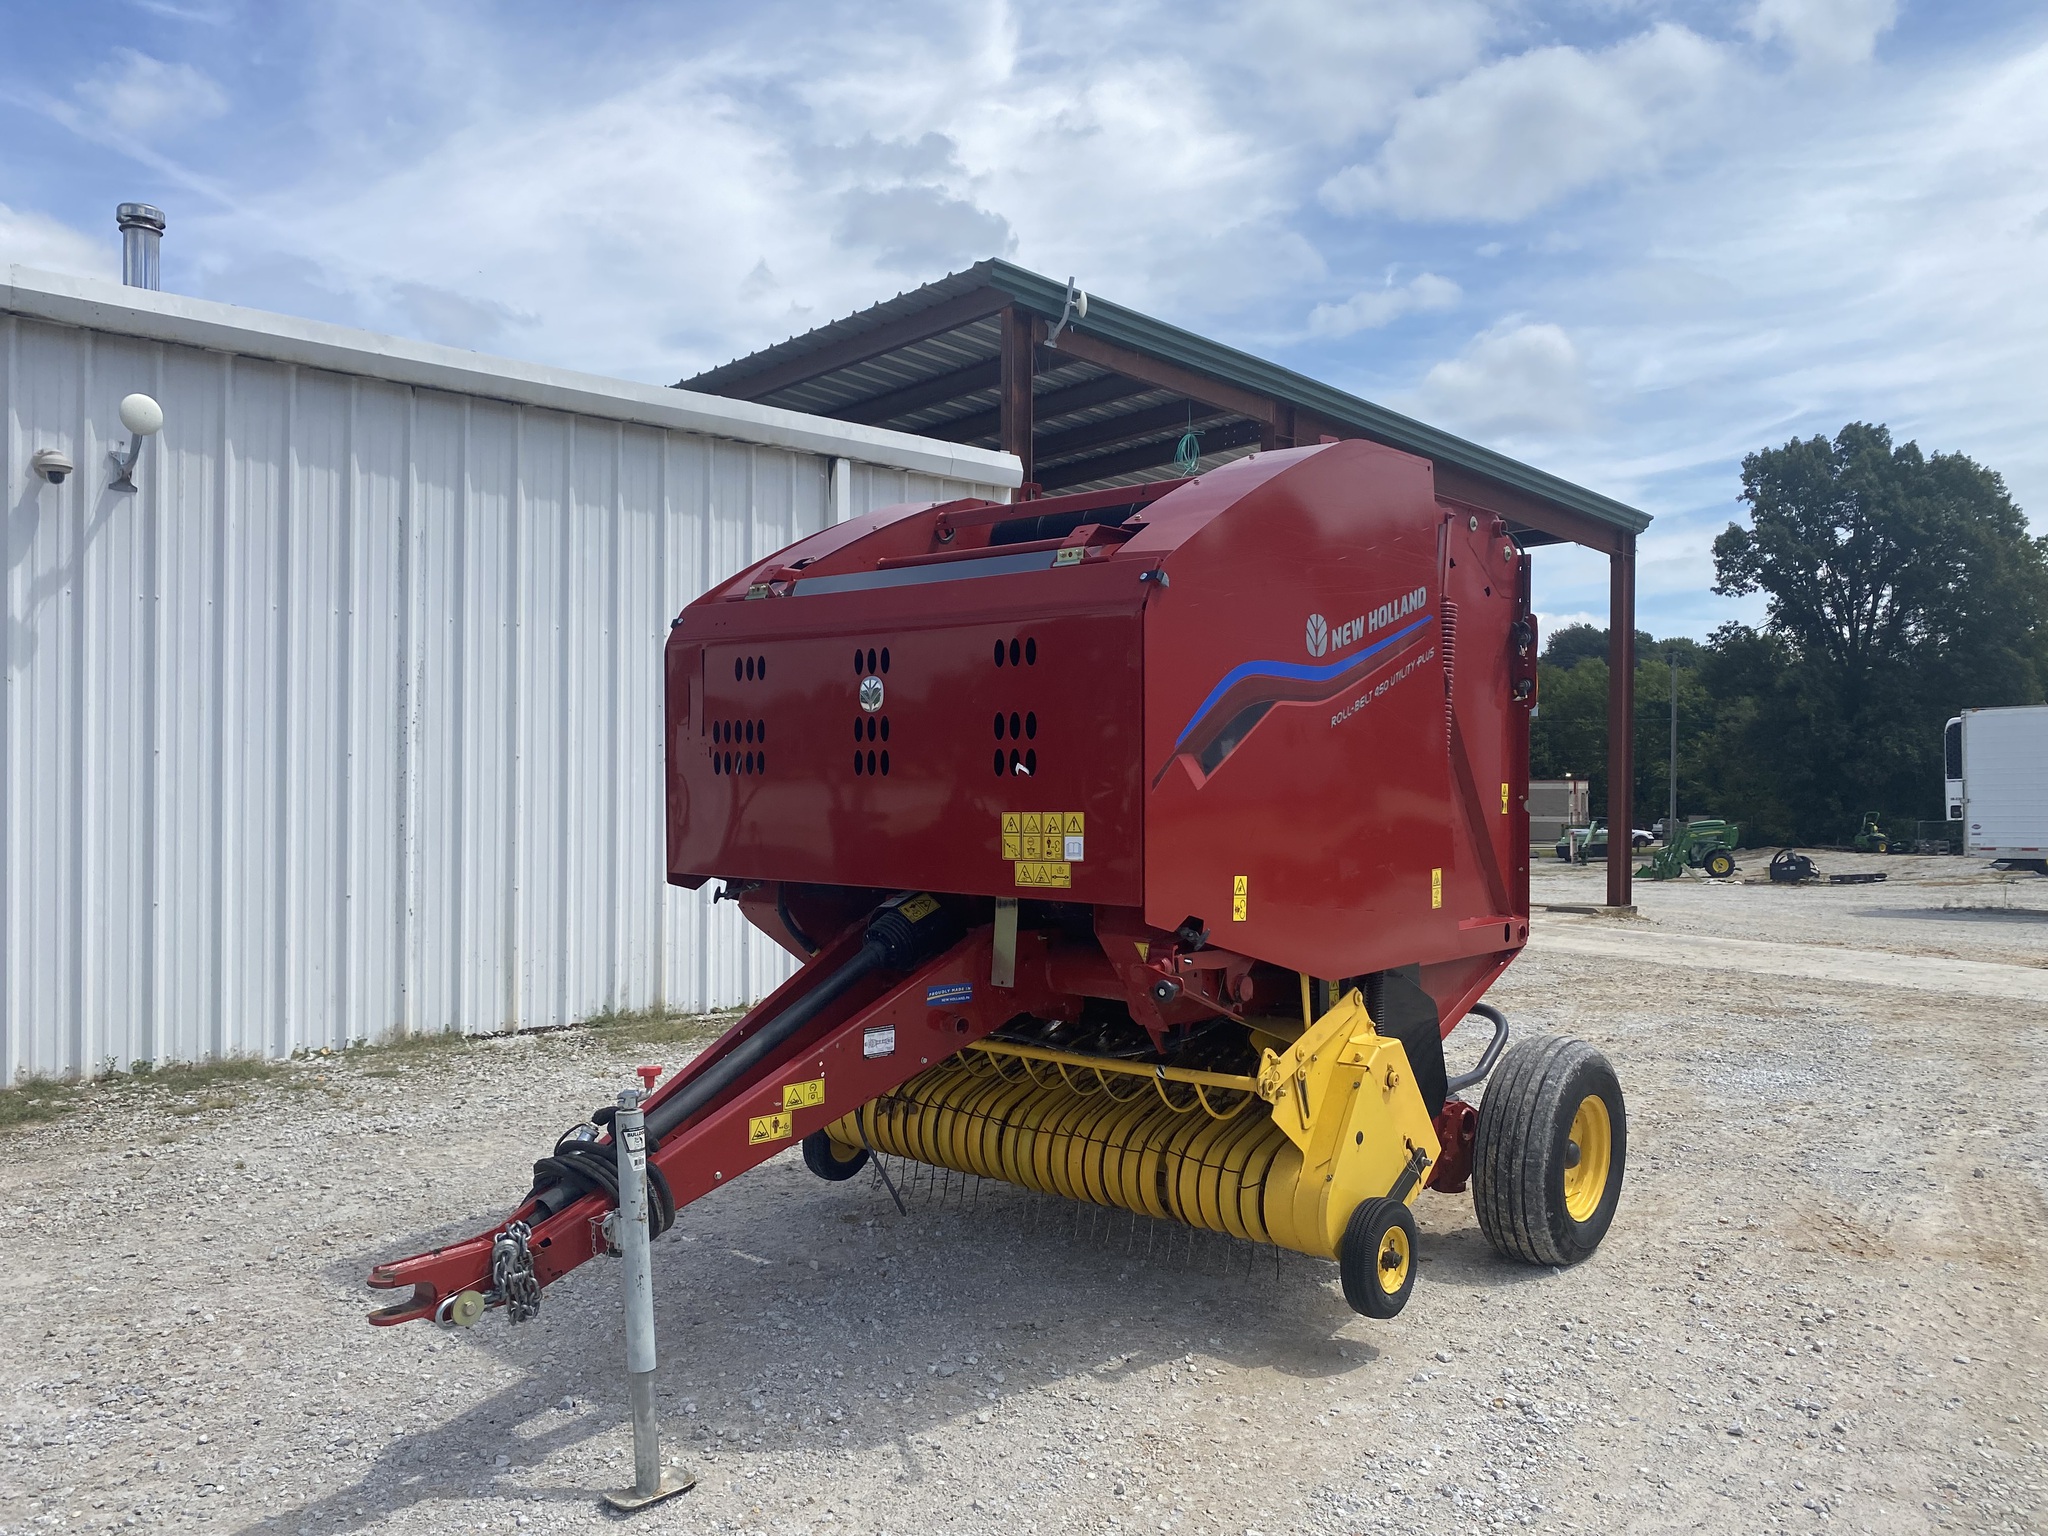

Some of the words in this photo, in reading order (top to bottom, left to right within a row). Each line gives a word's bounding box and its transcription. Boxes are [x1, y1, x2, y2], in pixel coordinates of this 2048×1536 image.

[1331, 615, 1365, 652] NEW
[1368, 586, 1427, 634] HOLLAND
[1330, 690, 1373, 728] ROLL-BELT
[1374, 679, 1389, 697] 450
[1390, 660, 1416, 686] UTILITY
[1416, 646, 1435, 667] PLUS
